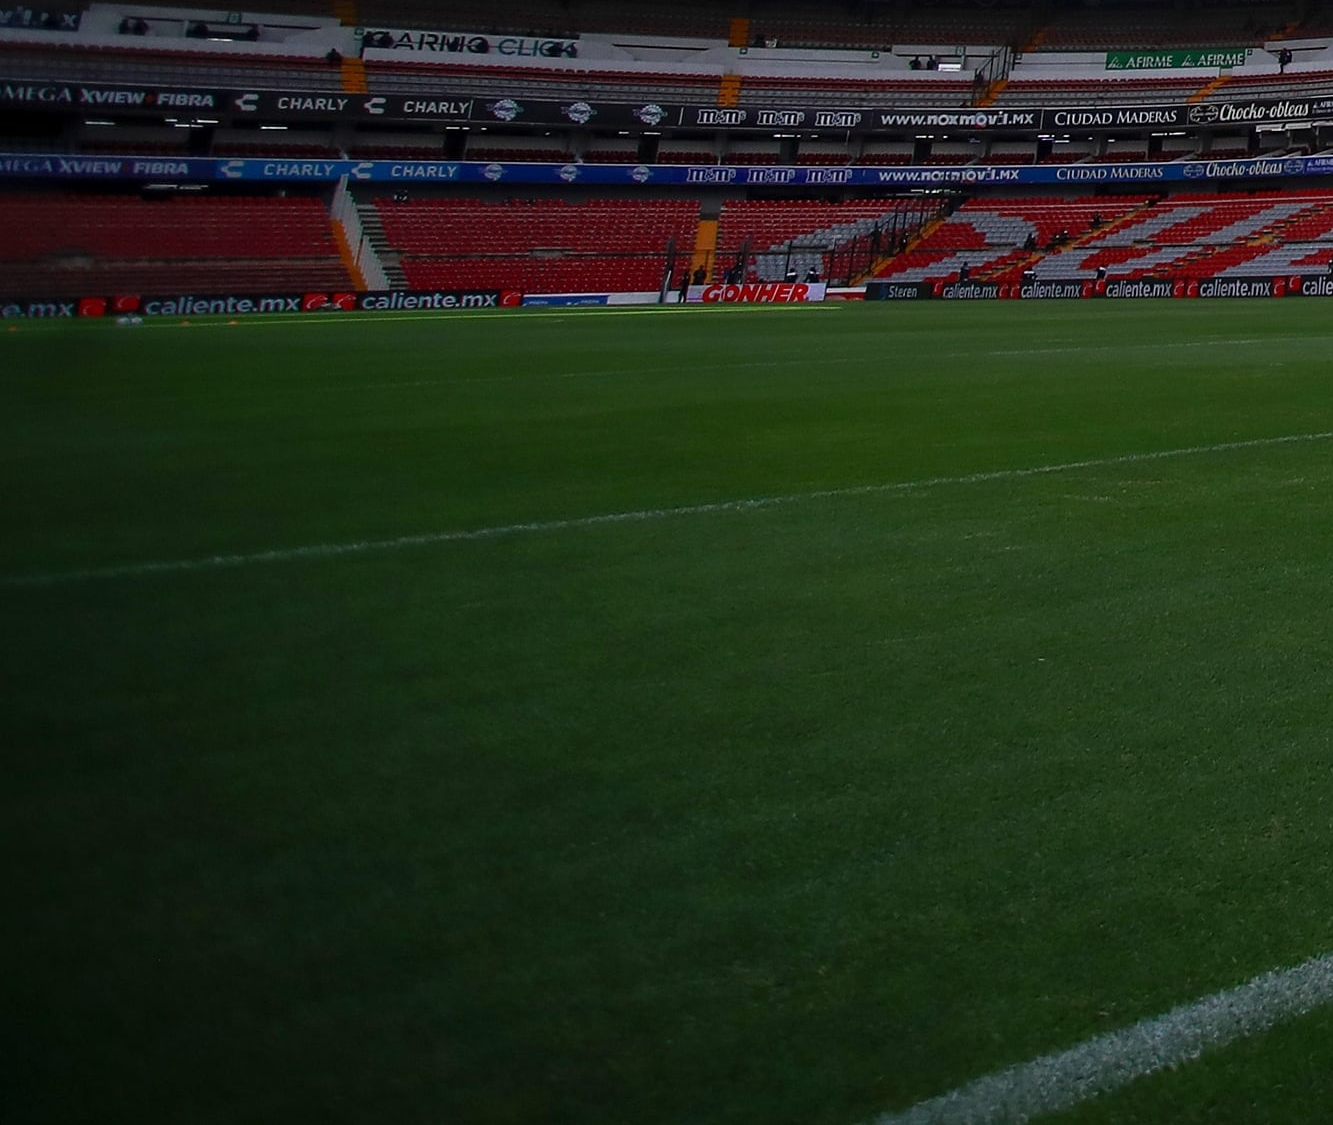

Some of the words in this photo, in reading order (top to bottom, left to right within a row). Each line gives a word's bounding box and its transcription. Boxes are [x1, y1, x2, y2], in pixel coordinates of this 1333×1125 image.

[1126, 54, 1173, 69] AFIRME
[1197, 51, 1244, 67] AFIRME
[79, 88, 146, 105] XVIEW
[157, 92, 215, 108] FIBRA
[278, 96, 349, 113] CHARLY
[403, 99, 470, 115] CHARLY
[1219, 100, 1309, 121] Chocko-obleas
[1055, 111, 1113, 125] CIUDAD
[1117, 109, 1178, 125] MADERAS
[60, 157, 122, 174] XVIEW
[132, 162, 190, 176] FIBRA
[264, 163, 335, 177] CHARLY
[390, 165, 457, 179] CHARLY
[1056, 167, 1107, 180] CIUDAD
[1110, 166, 1164, 179] MADERAS
[1206, 160, 1283, 177] Chocko-obleas
[703, 283, 808, 303] GONHER
[888, 286, 918, 300] Steren
[943, 283, 998, 300] caliente.mx
[1021, 281, 1081, 300] caliente.mx
[1105, 279, 1172, 299] caliente.mx
[1200, 278, 1271, 298] caliente.mx
[146, 295, 301, 316] caliente.mx
[362, 291, 497, 311] caliente.mx
